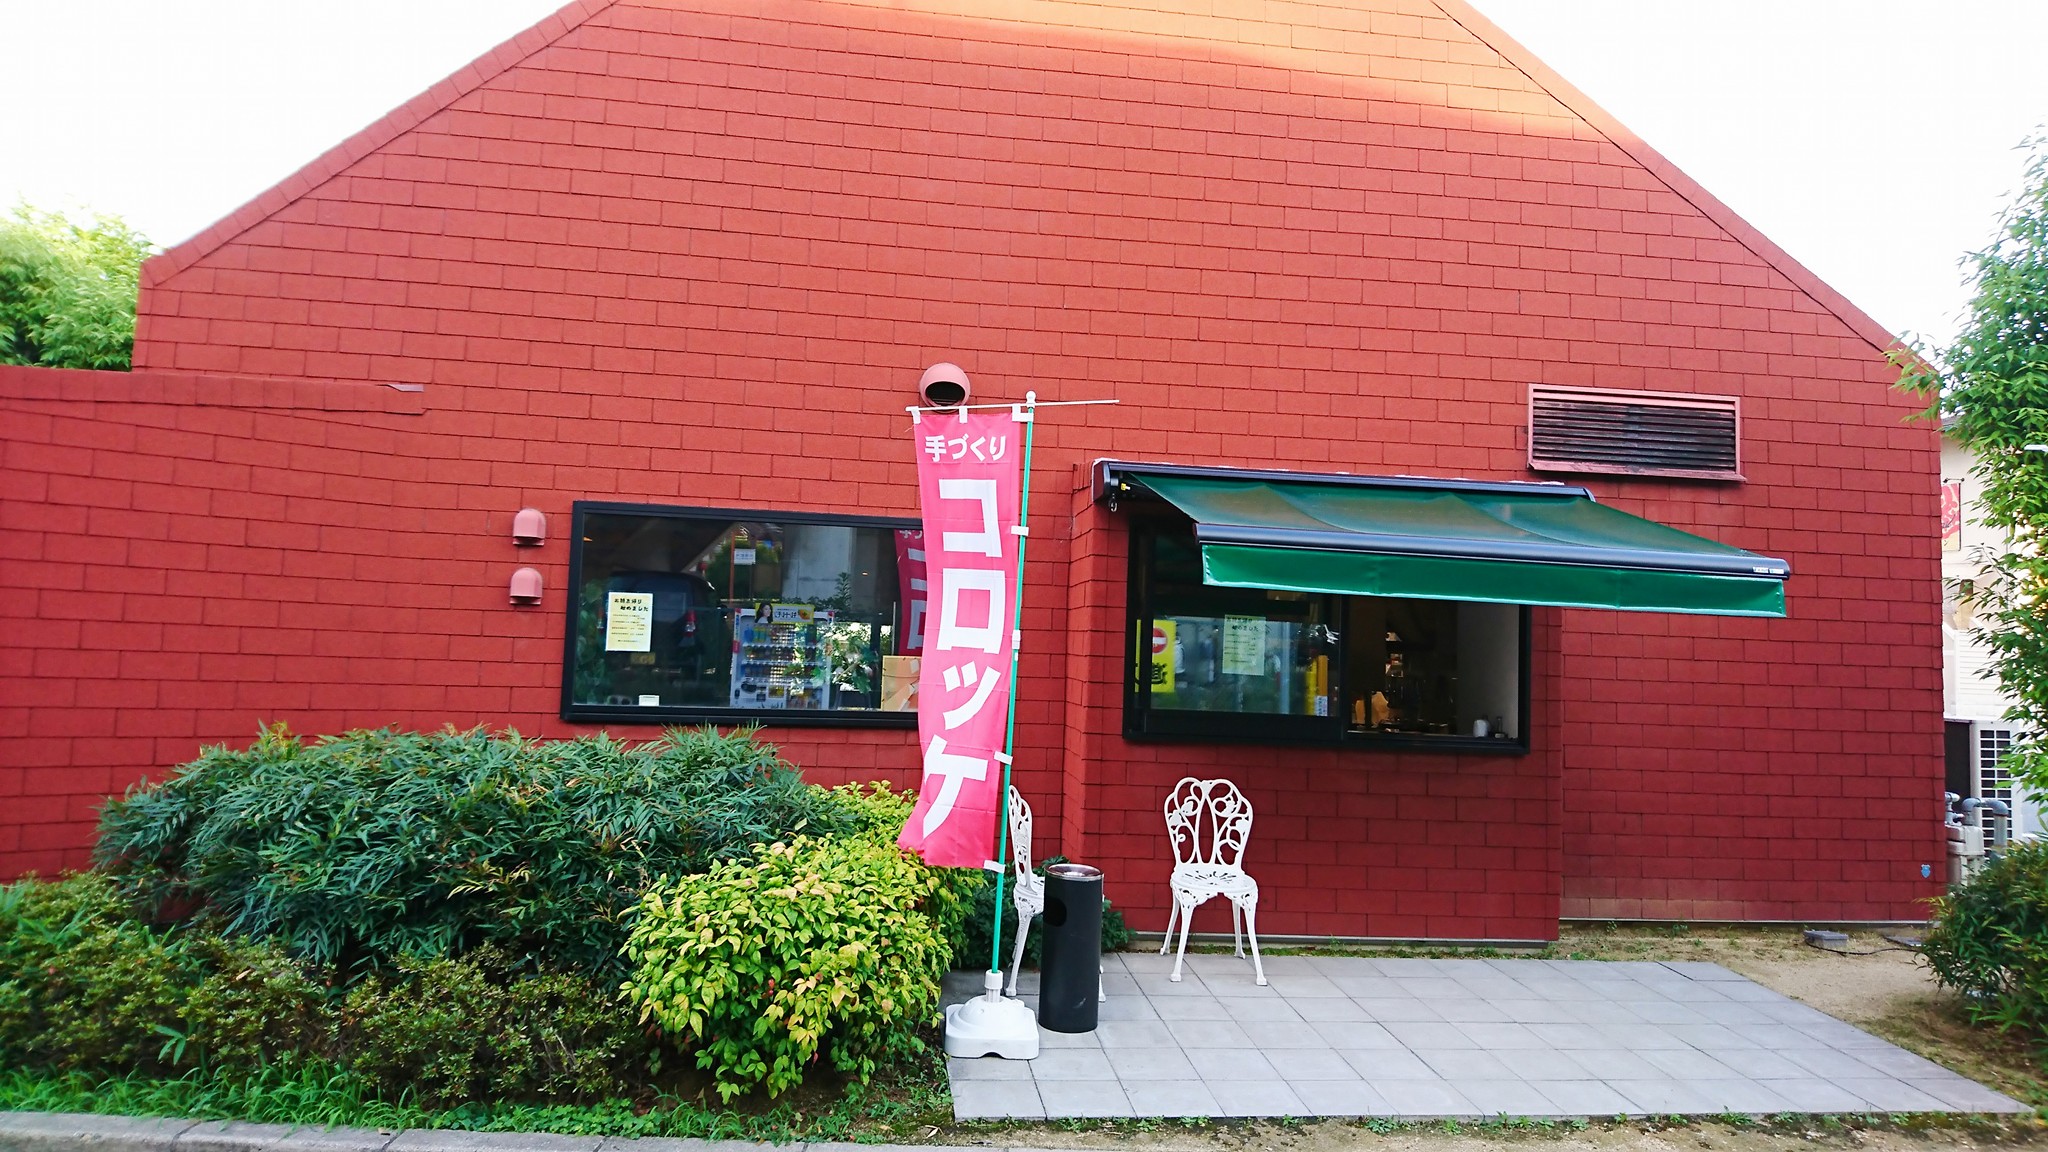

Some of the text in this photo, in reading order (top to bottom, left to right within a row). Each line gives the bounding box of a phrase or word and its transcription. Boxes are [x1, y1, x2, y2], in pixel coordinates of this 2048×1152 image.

[925, 433, 1006, 462] 手づくり
[923, 479, 1006, 839] コロッケ
